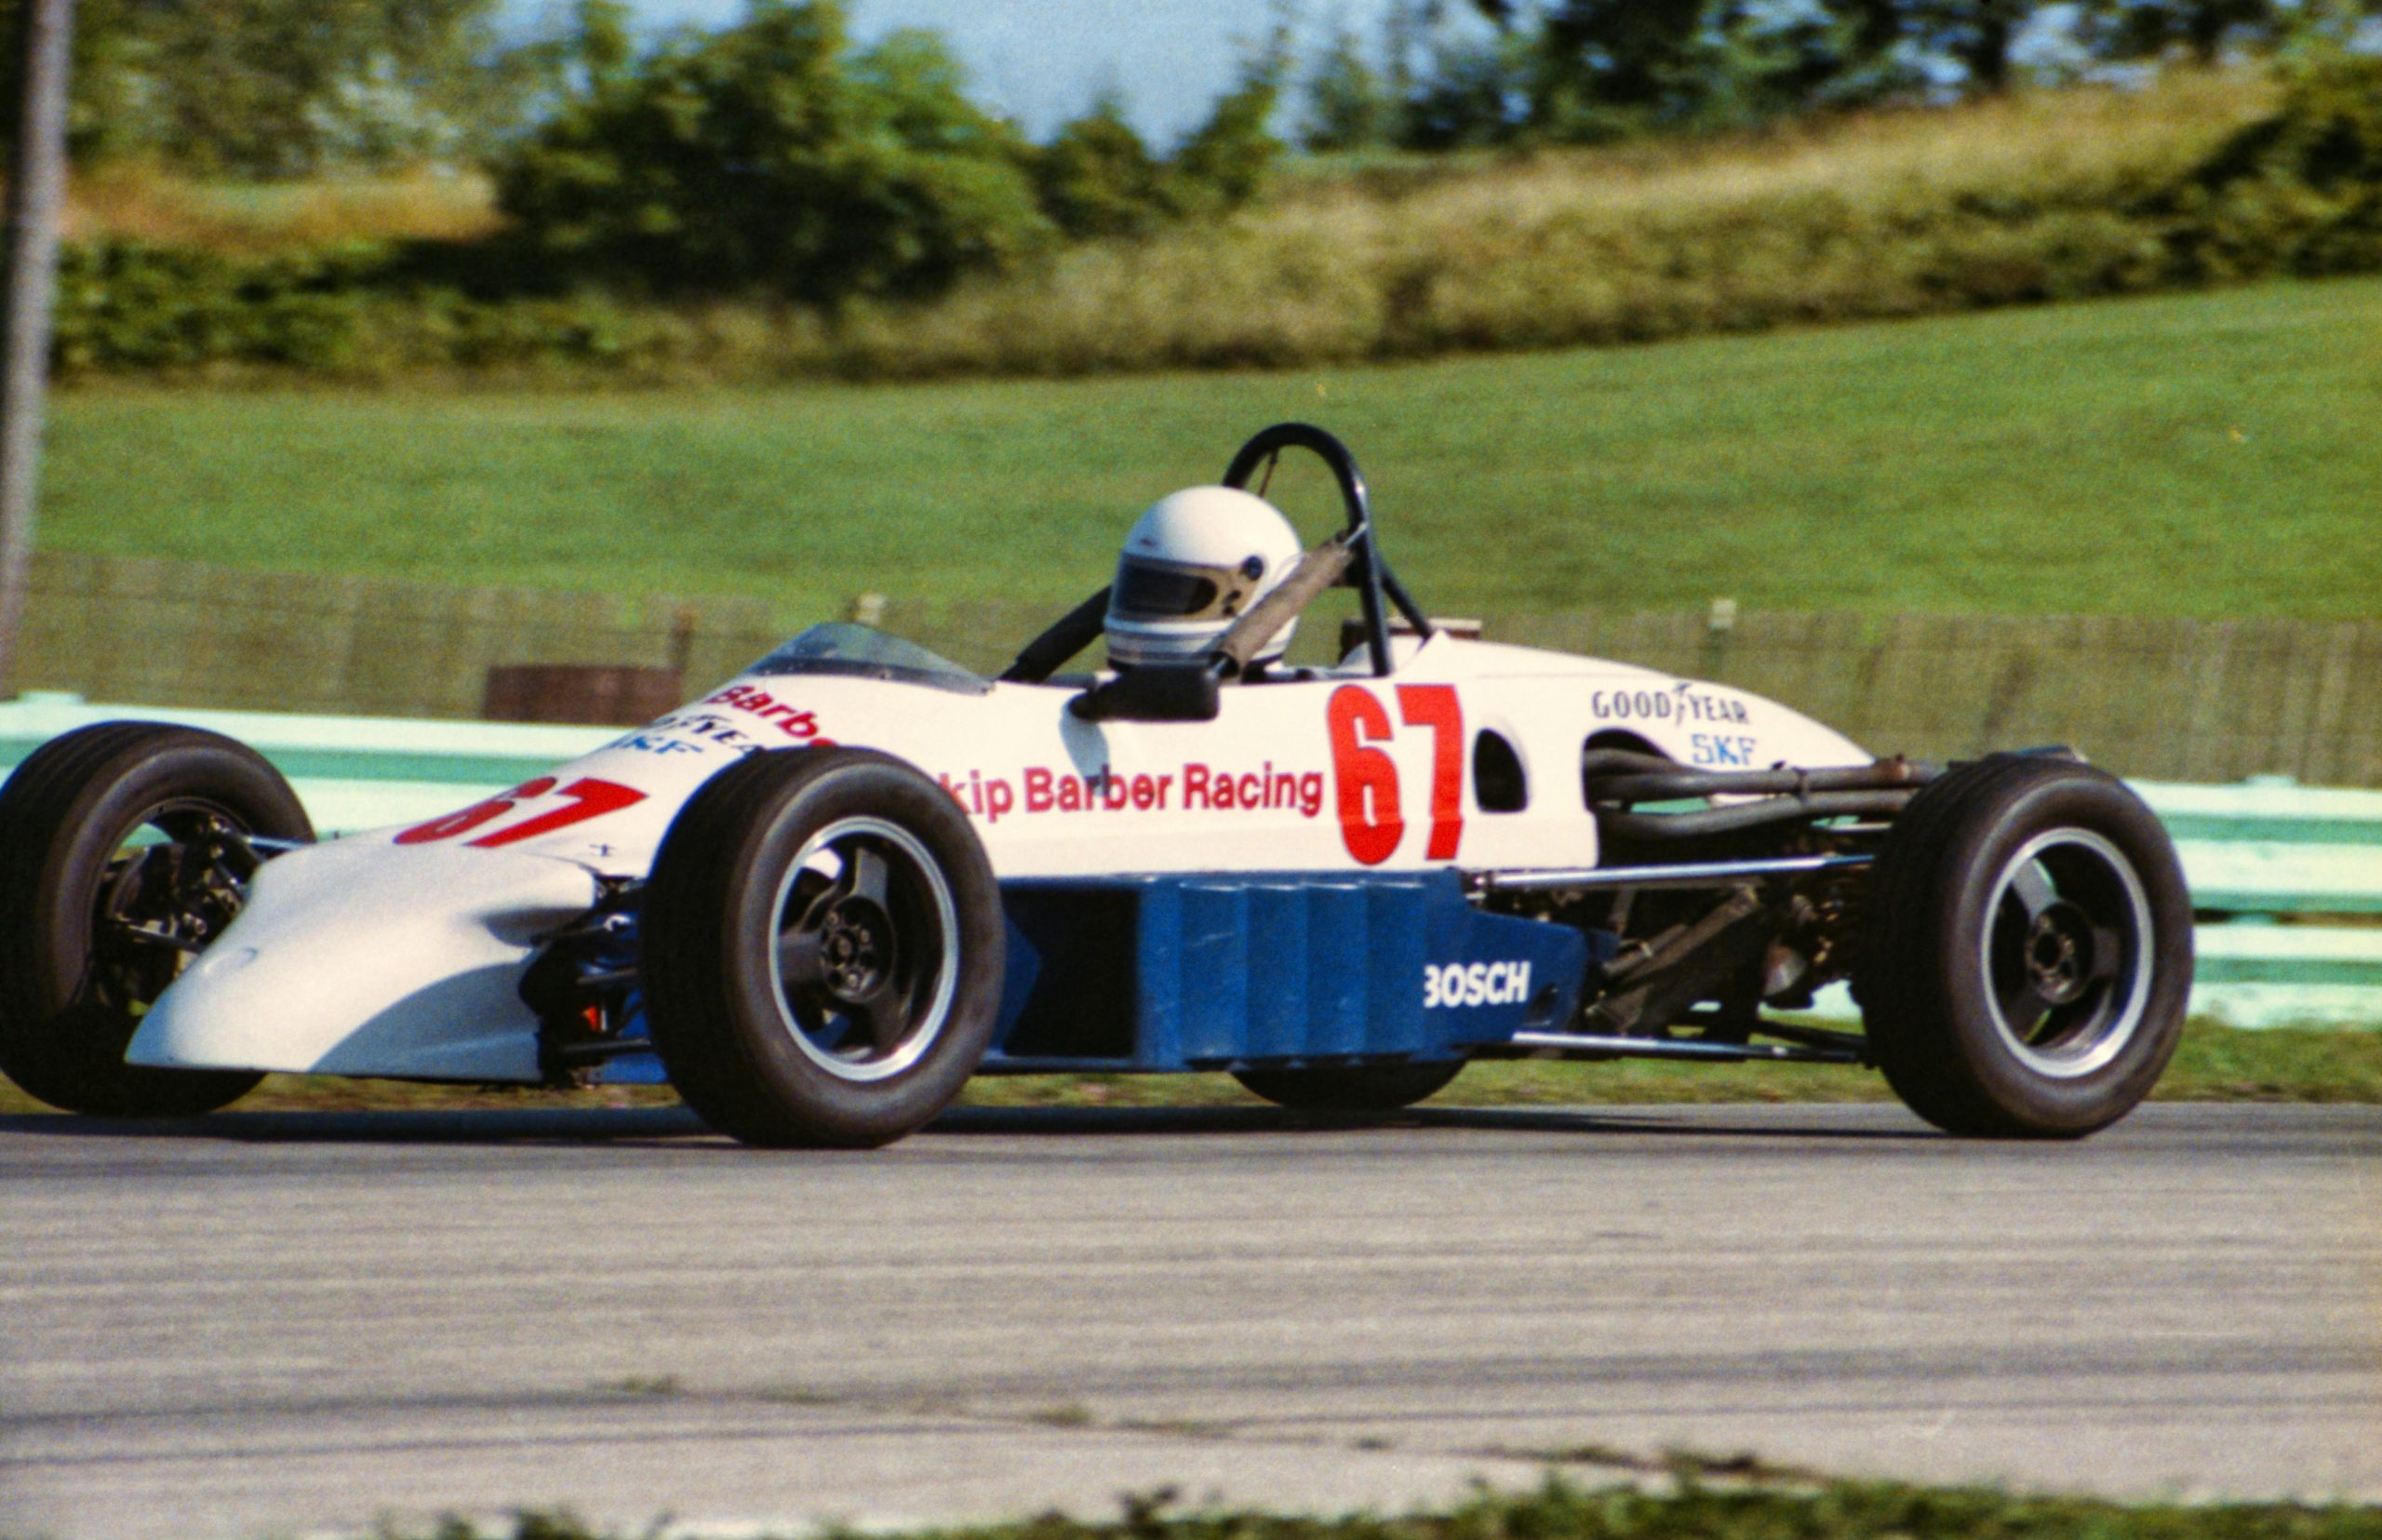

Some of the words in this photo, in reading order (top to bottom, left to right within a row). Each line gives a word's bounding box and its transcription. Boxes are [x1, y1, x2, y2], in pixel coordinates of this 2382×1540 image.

[1328, 684, 1464, 864] 67
[1691, 733, 1757, 765] SKF
[393, 776, 650, 848] 67
[938, 769, 1014, 824] kip
[1024, 764, 1173, 813] Barber
[1183, 762, 1324, 818] Racing
